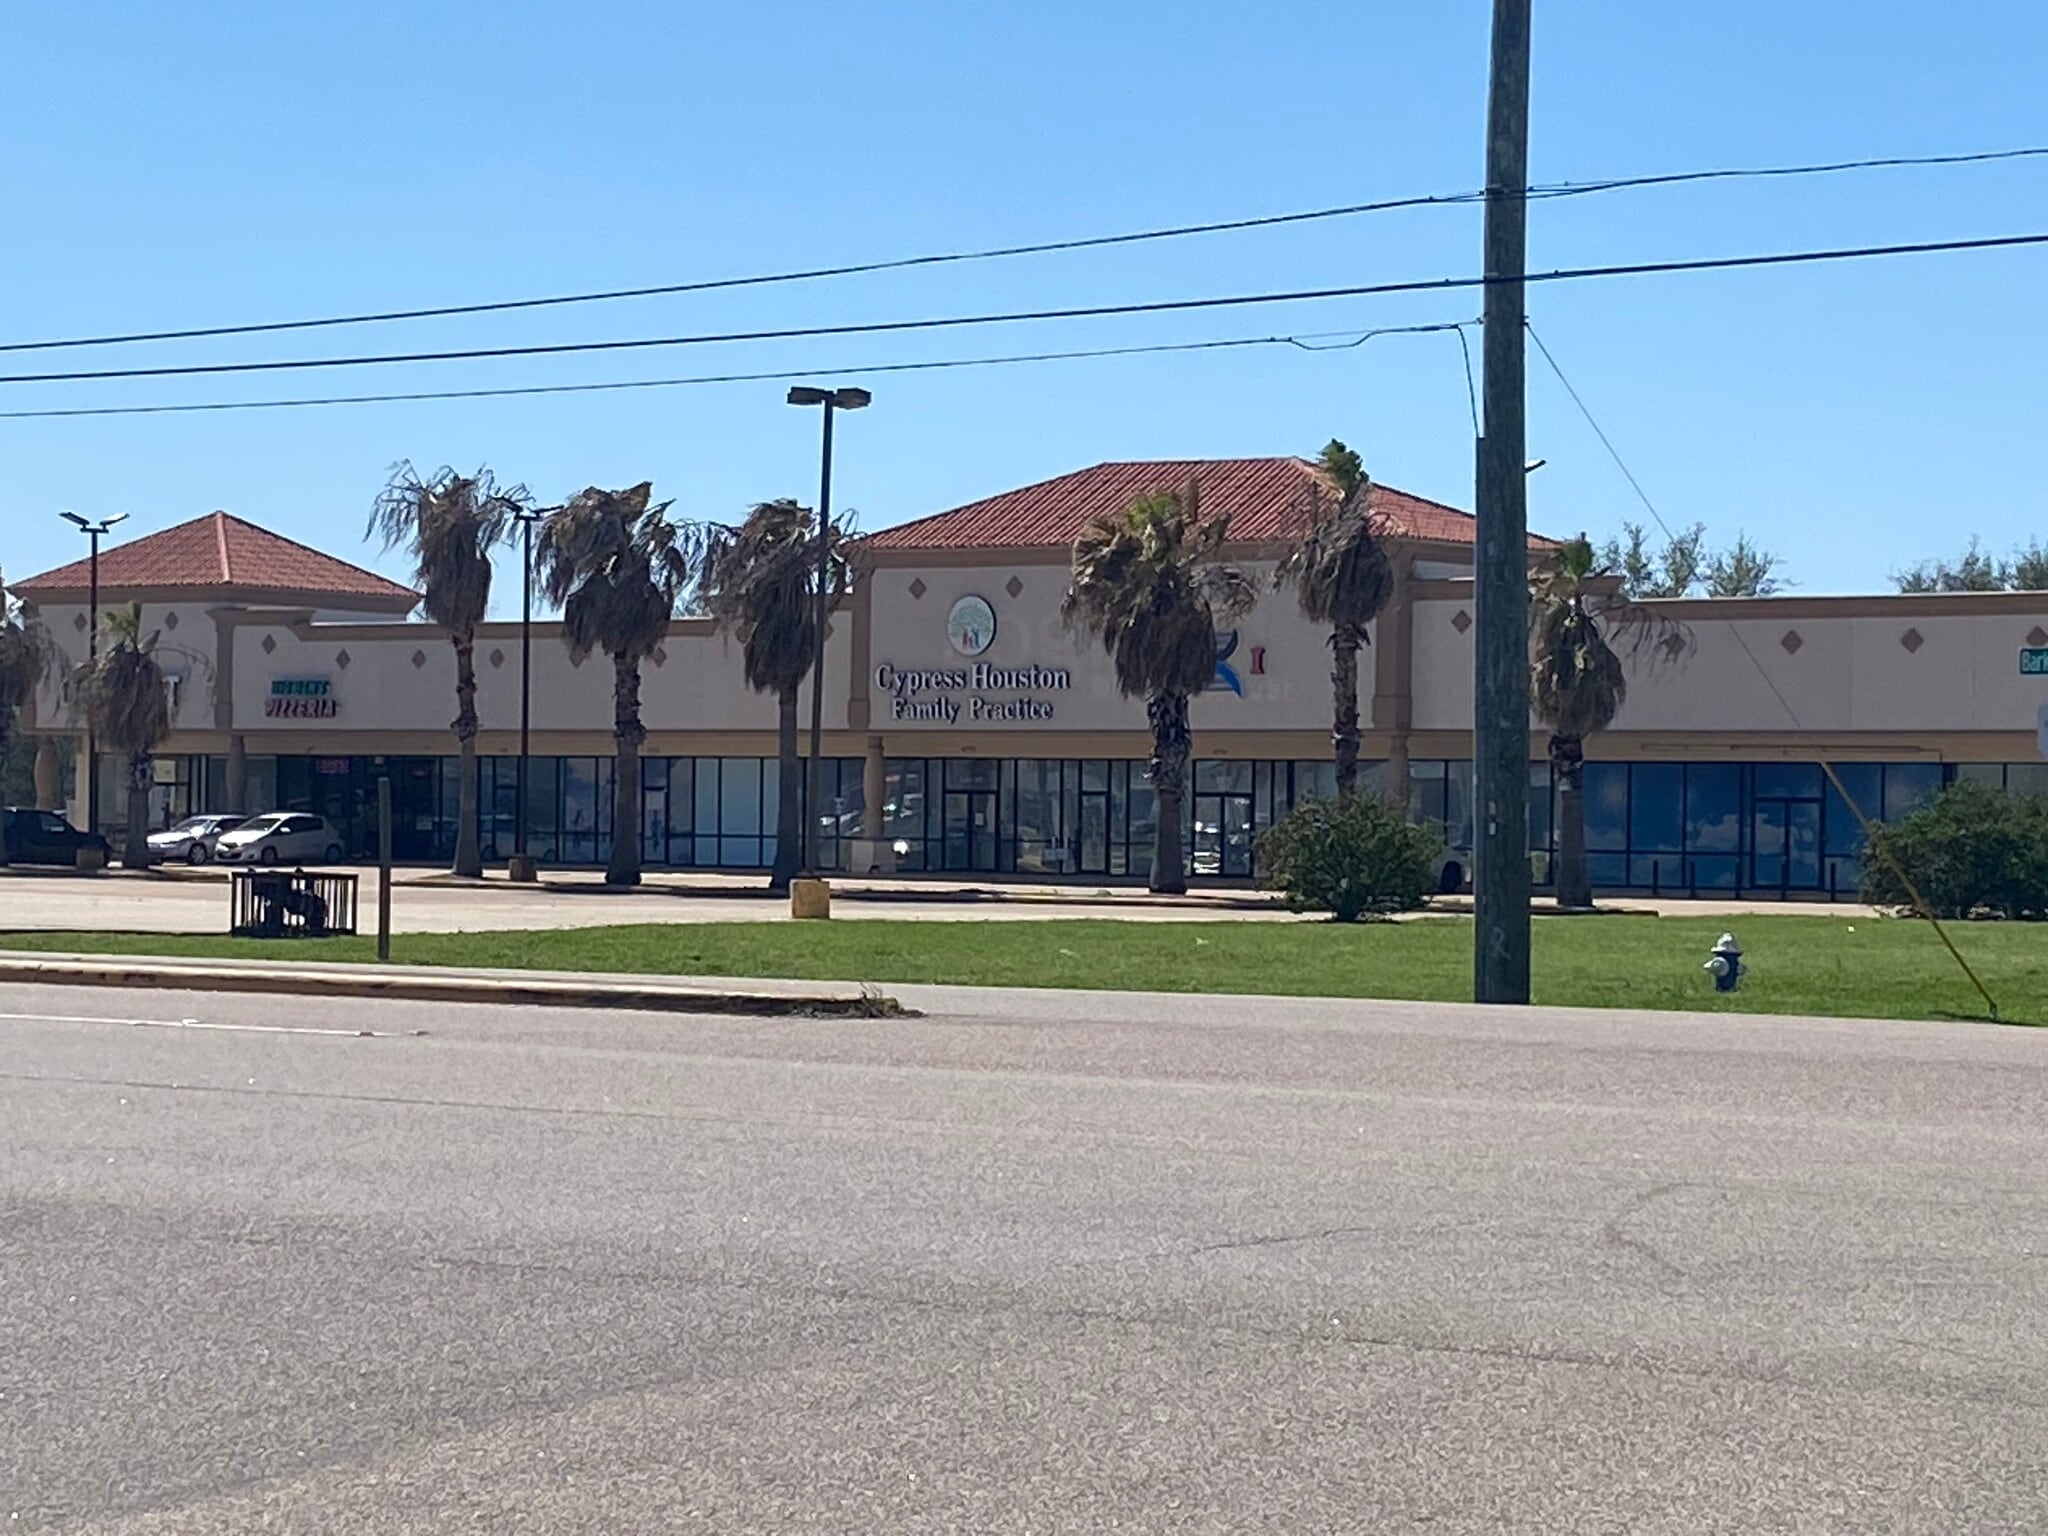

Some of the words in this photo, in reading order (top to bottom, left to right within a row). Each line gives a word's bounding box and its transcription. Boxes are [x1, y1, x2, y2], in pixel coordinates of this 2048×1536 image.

[875, 663, 967, 697] Cypress
[970, 662, 1071, 690] Houston
[265, 699, 337, 718] PIZZERIA
[891, 697, 961, 725] Family
[968, 697, 1054, 721] Practice
